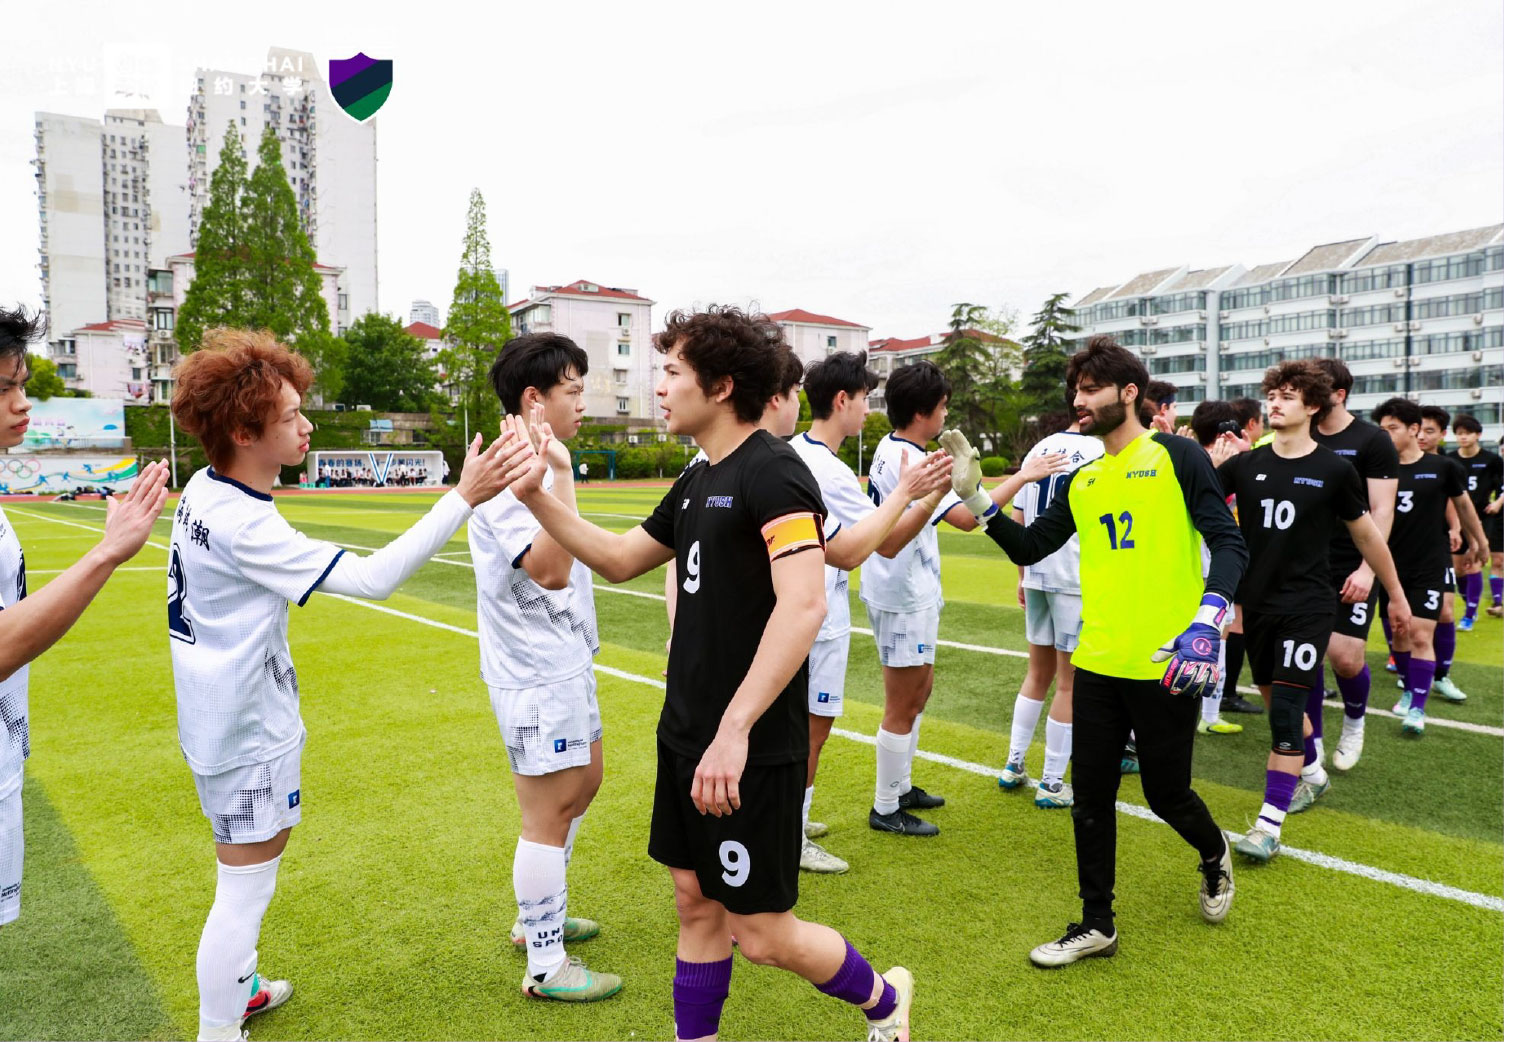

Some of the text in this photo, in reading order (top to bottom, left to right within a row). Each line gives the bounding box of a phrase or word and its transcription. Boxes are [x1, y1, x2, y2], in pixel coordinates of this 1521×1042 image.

[1126, 469, 1157, 479] NYUSH
[1468, 476, 1478, 491] 5
[1397, 490, 1414, 513] 3
[1260, 498, 1296, 530] 10
[1098, 510, 1135, 550] 12
[1423, 589, 1441, 611] 3
[1349, 602, 1369, 626] 5
[1282, 639, 1318, 671] 10
[718, 840, 751, 888] 9
